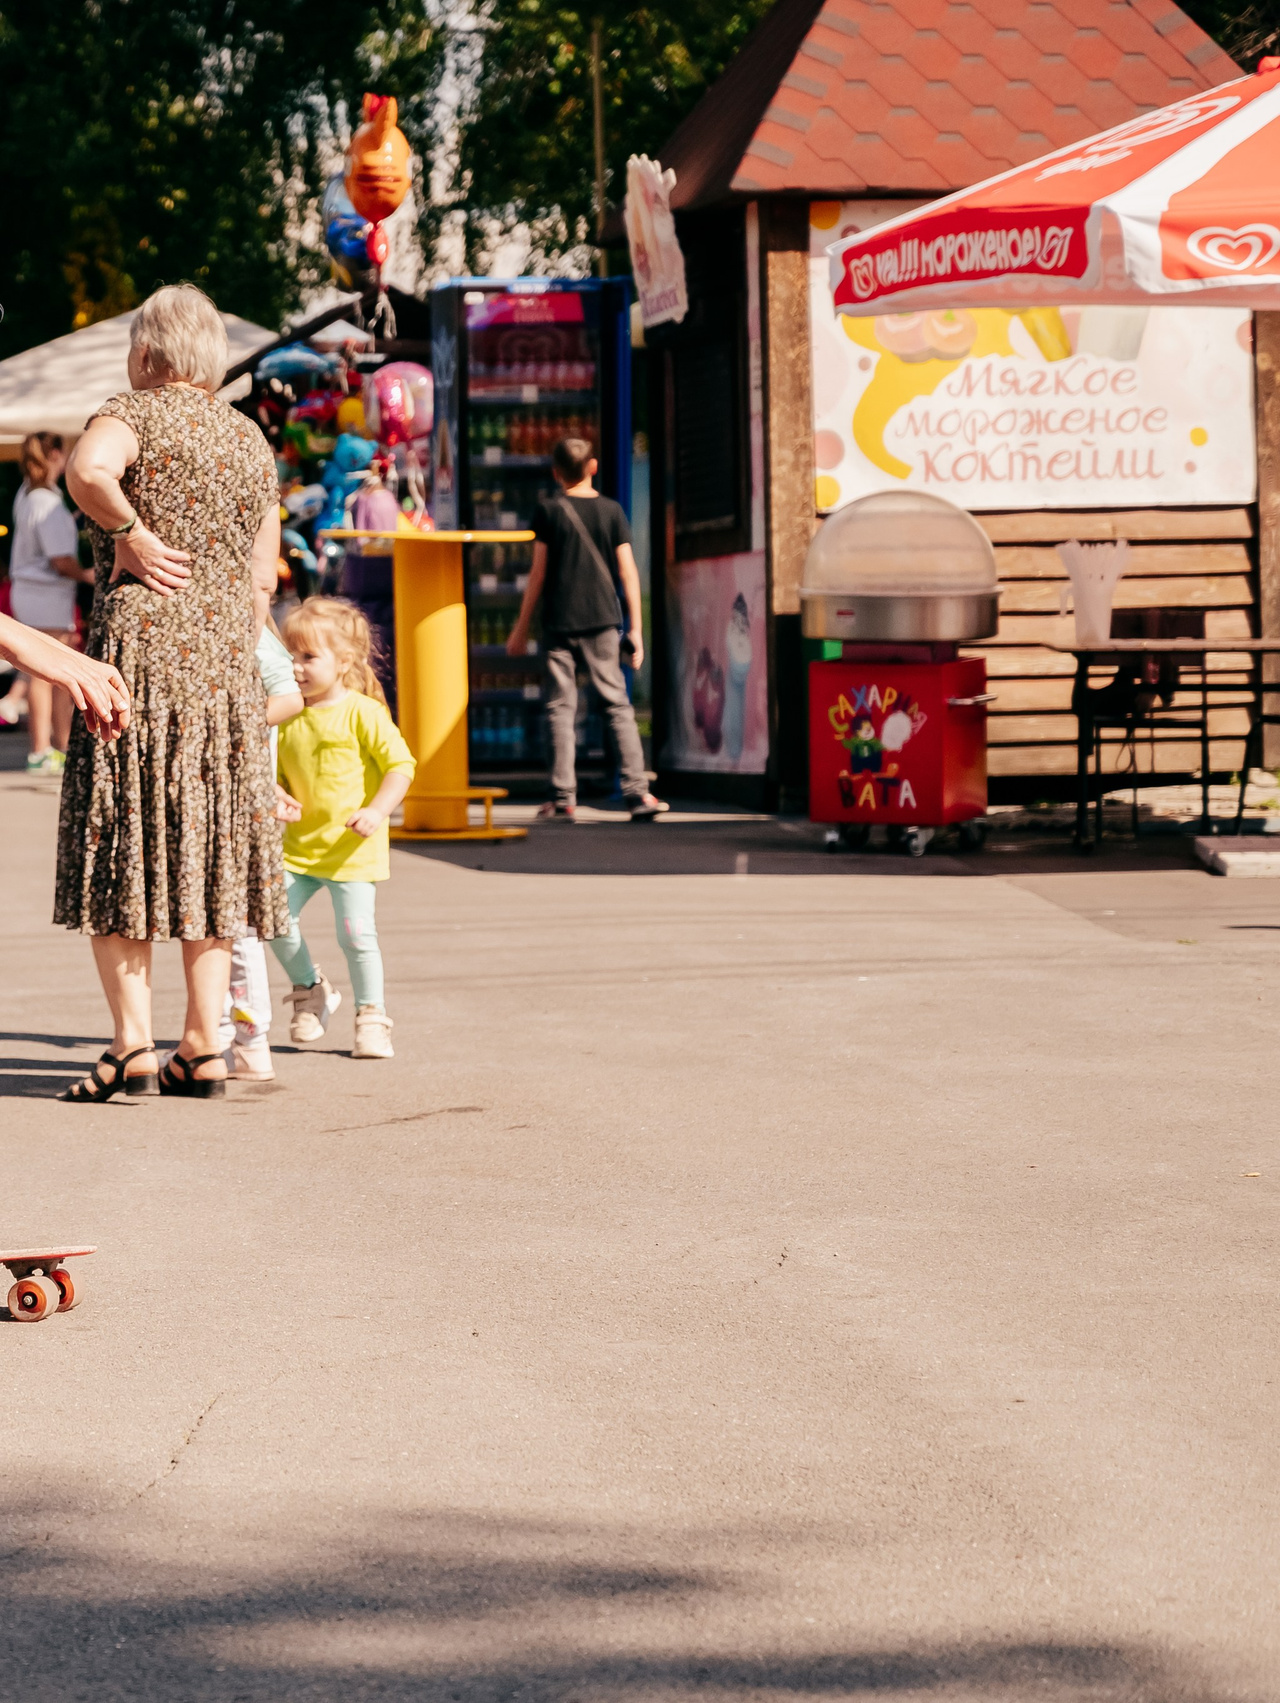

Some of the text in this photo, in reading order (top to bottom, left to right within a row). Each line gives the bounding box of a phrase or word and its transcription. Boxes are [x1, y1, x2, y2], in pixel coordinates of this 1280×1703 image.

[946, 358, 1138, 398] Мягкое
[895, 405, 1168, 445] мороженое
[838, 776, 917, 810] ВАТА
